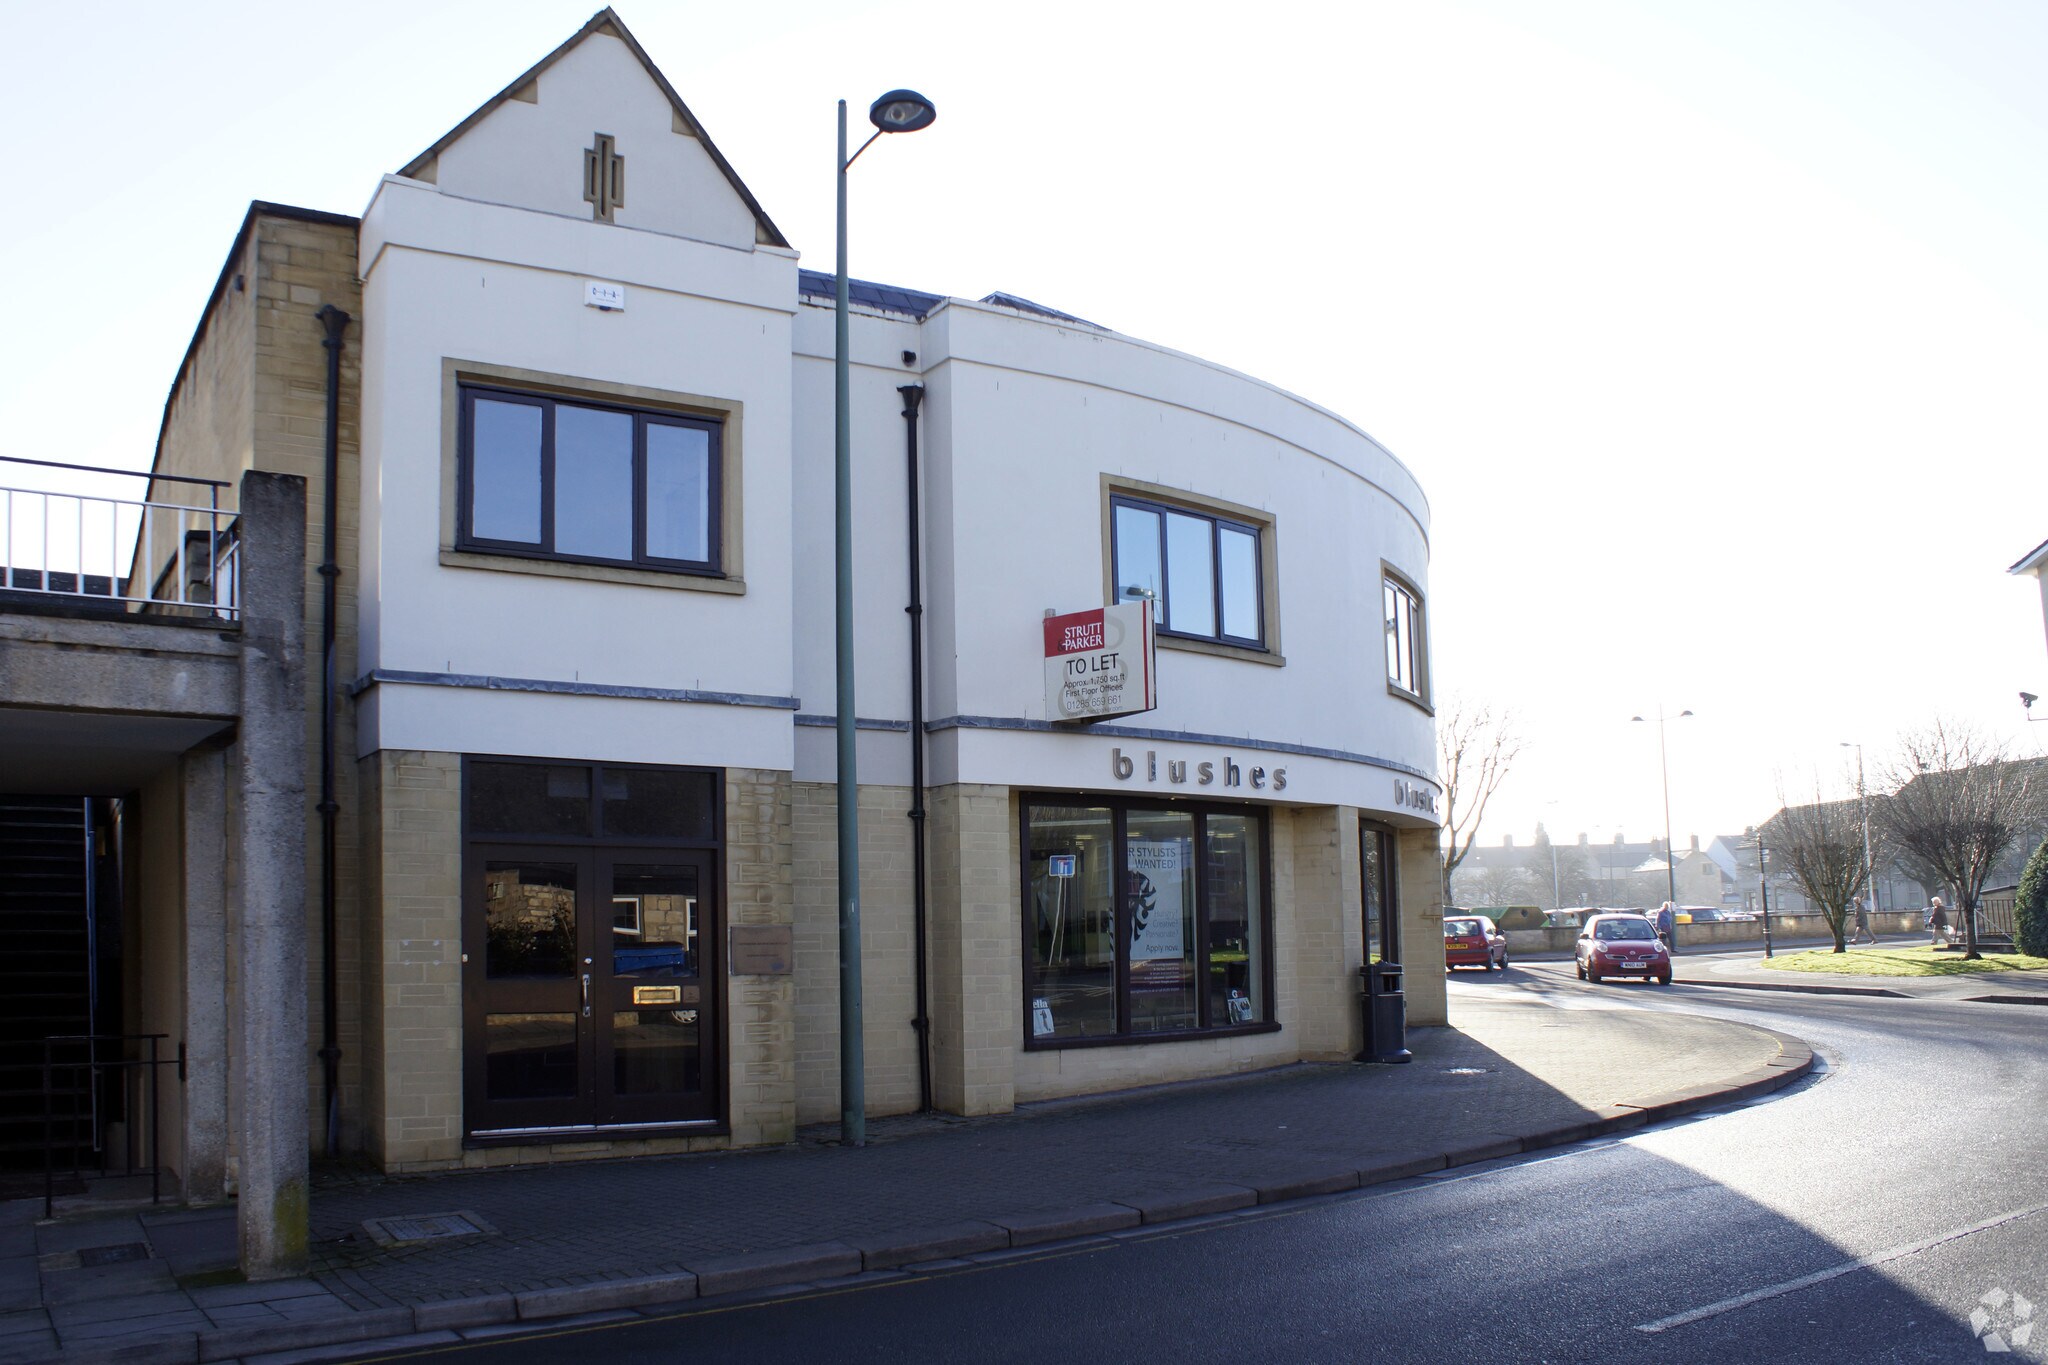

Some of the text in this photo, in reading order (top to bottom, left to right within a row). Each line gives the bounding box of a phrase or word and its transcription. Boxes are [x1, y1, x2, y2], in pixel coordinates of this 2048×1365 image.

[1065, 622, 1102, 639] STRUTT
[1065, 635, 1103, 651] PARKER
[1066, 653, 1119, 675] TO LET
[1065, 684, 1124, 697] First Floor Offices
[1107, 694, 1121, 704] 661
[1112, 748, 1287, 791] blushes
[1137, 847, 1176, 857] STYLISTS
[1134, 859, 1176, 869] WANTED!
[1145, 944, 1163, 954] Apply
